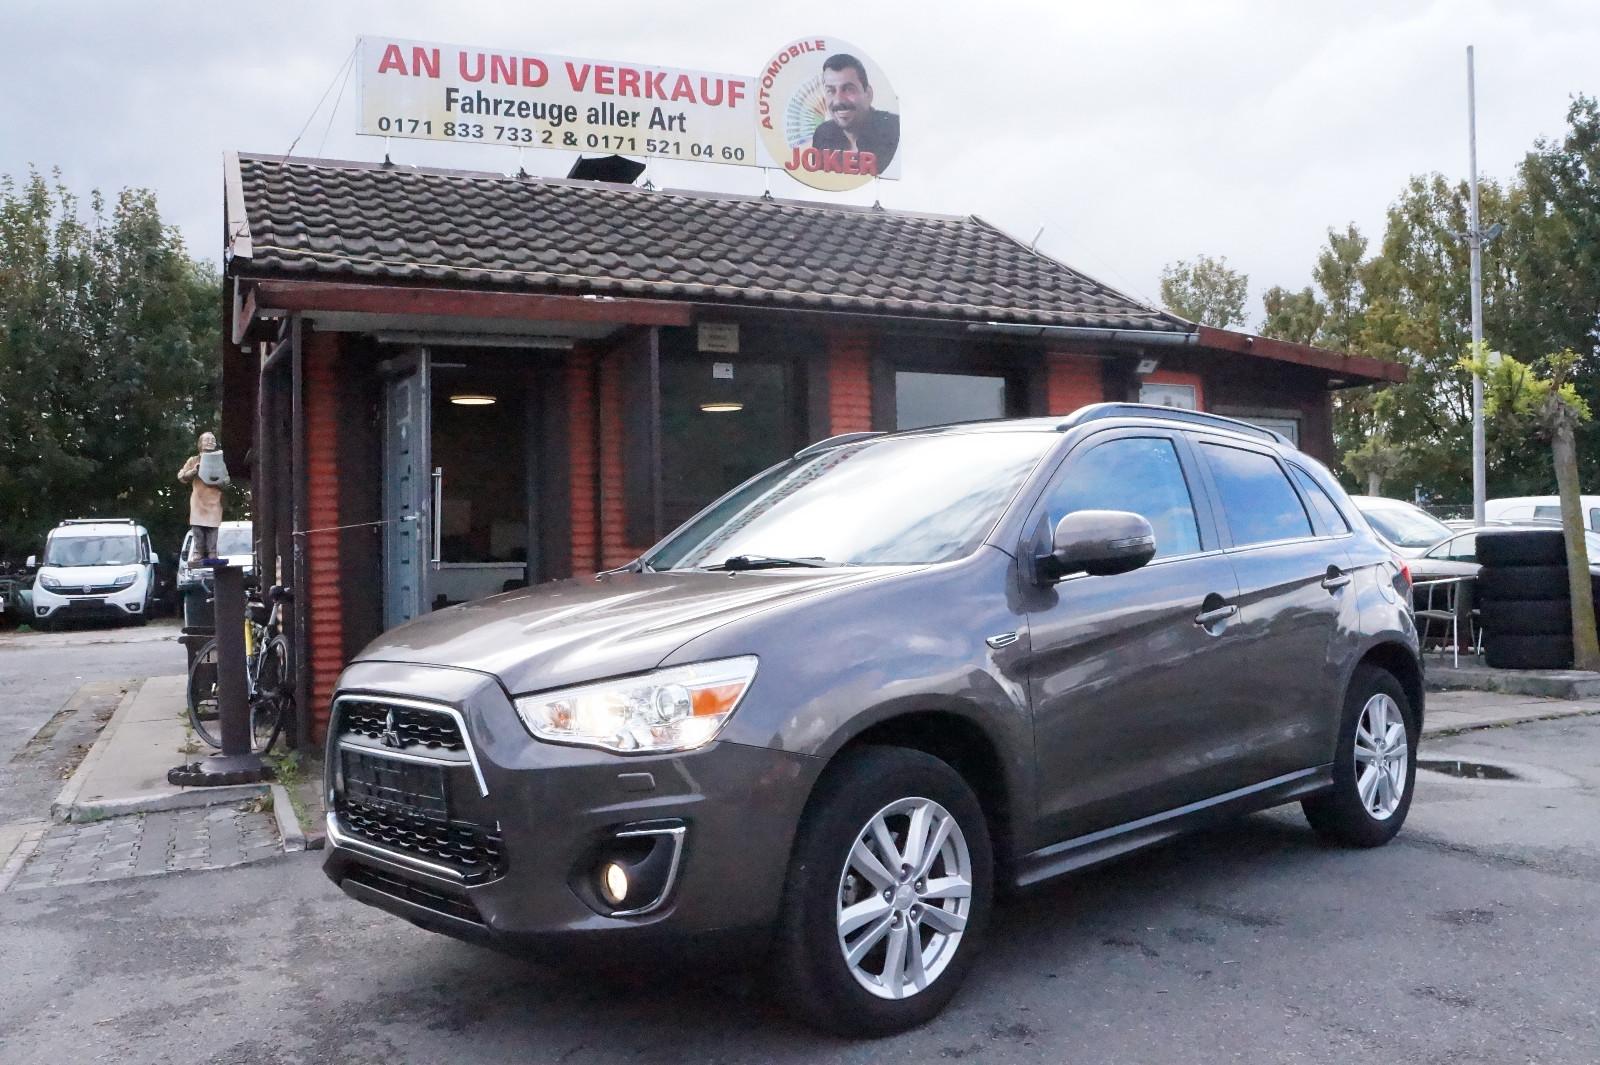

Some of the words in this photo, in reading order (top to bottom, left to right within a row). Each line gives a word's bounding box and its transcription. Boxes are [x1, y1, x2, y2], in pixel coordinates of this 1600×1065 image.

[378, 44, 440, 78] AN
[459, 51, 548, 88] UND
[564, 62, 745, 108] VERKAUF
[760, 40, 826, 130] AUTOMOBILE
[445, 87, 577, 127] Fahrzeuge
[587, 102, 640, 127] aller
[648, 106, 686, 133] Art
[378, 116, 432, 135] 0171
[443, 122, 484, 138] 833
[494, 125, 533, 143] 733
[541, 130, 553, 144] 2
[562, 131, 578, 146] &
[587, 134, 636, 151] 0171
[646, 139, 680, 155] 521
[691, 143, 714, 158] 04
[721, 146, 744, 161] 60
[784, 147, 879, 176] JOKER
